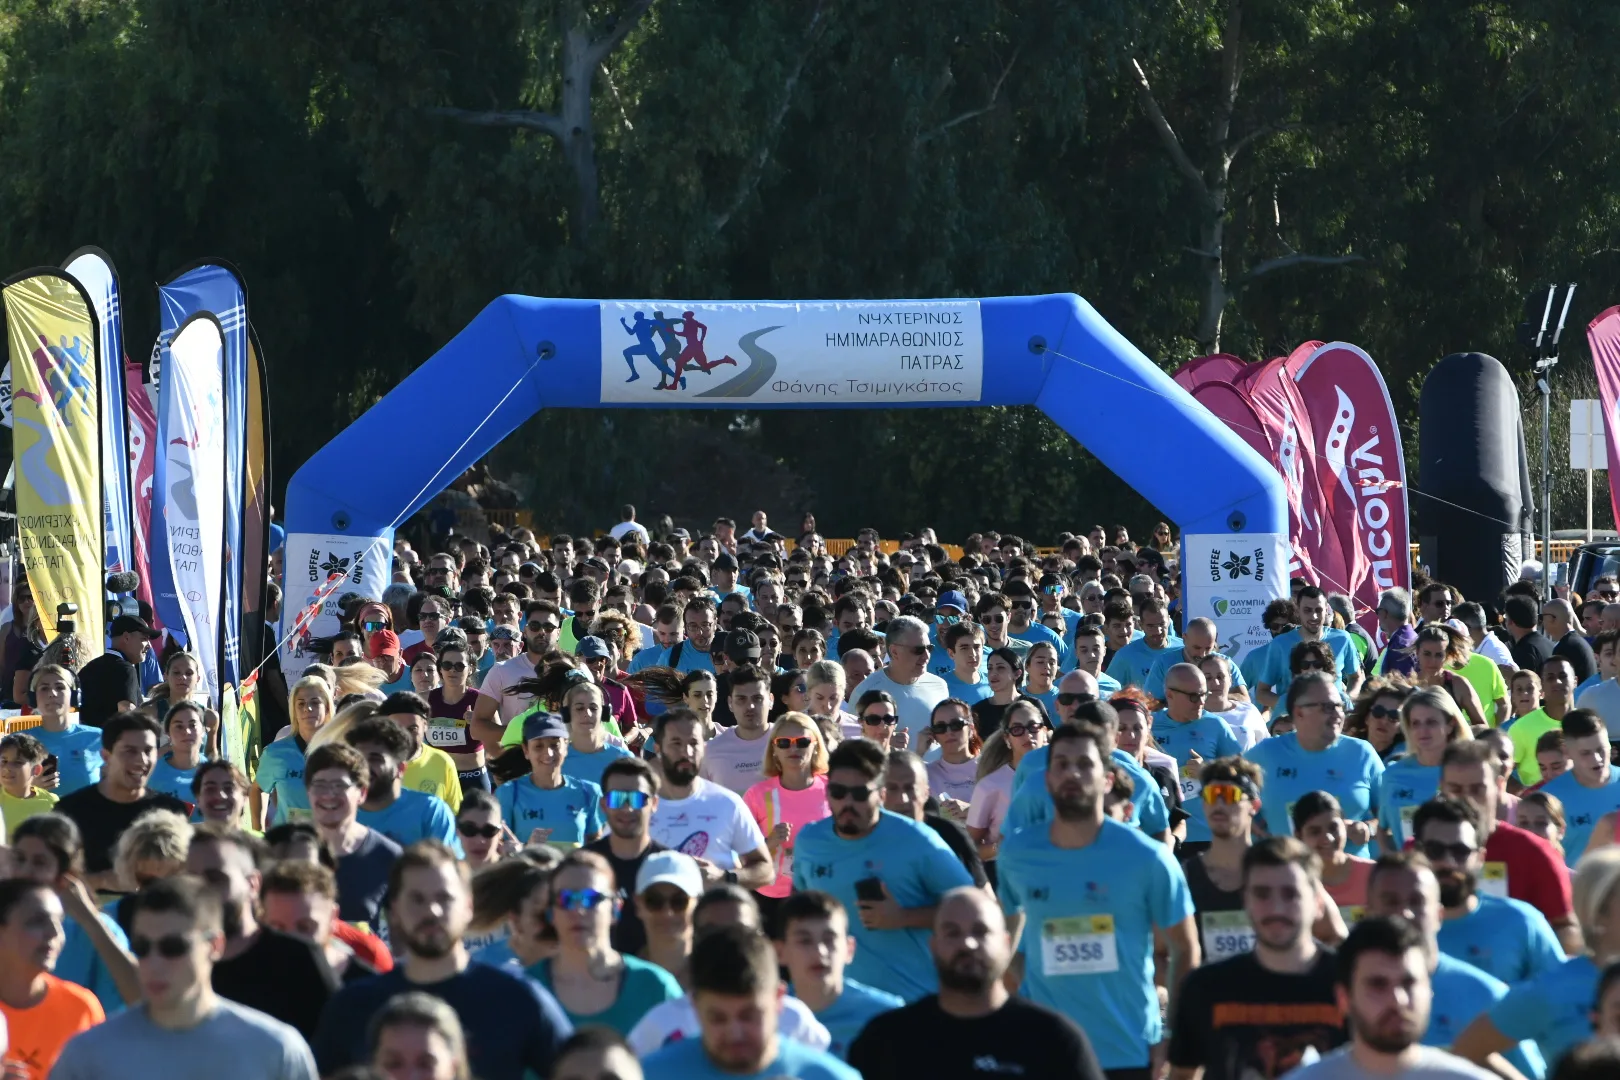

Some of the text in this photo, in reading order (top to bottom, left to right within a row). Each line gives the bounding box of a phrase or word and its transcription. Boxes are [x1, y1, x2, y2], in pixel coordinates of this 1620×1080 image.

[826, 331, 964, 347] ΗΜΙΜΑΡΑΘΩΝΙΟΣ
[901, 354, 964, 370] ΠΑΤΡΑΣ
[772, 379, 963, 396] Φάνης Τσιμιγκάτος
[309, 548, 364, 585] COFFEE ISLAND
[1210, 548, 1221, 582] COFFEE
[1254, 547, 1265, 581] ISLAND
[1229, 607, 1252, 615] ΟΔΟΣ
[1230, 599, 1266, 607] ΟΛΥΜΠΙΑ
[432, 730, 458, 741] 6150
[1054, 942, 1104, 963] 5358
